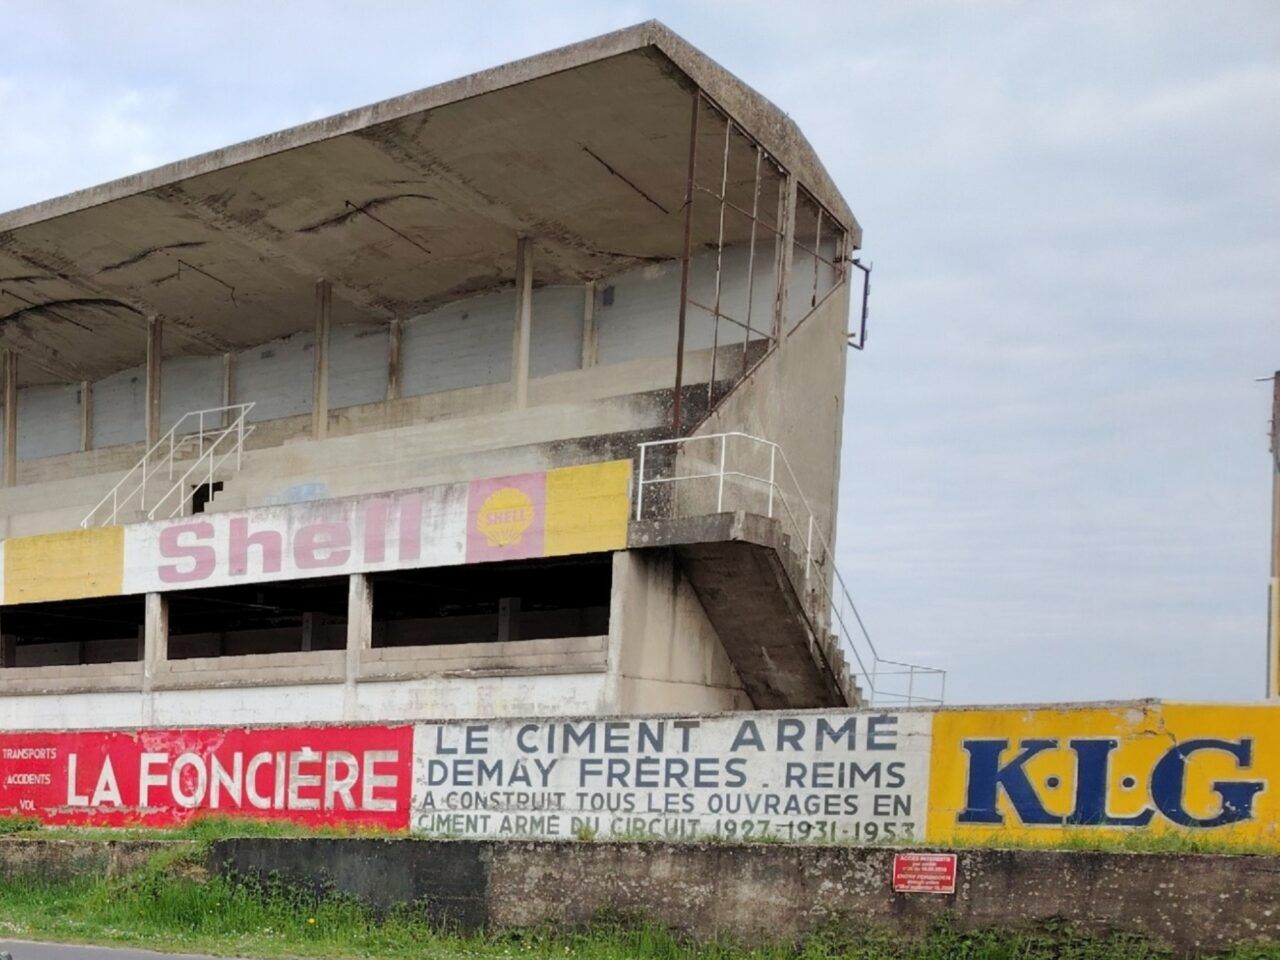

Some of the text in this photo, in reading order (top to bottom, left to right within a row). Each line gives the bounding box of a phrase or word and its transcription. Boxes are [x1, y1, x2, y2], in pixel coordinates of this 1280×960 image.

[486, 507, 527, 526] SHELL
[157, 499, 421, 584] Shell
[436, 724, 489, 755] LE
[516, 721, 700, 754] CIMENT
[2, 748, 57, 760] TRANSPORTS
[7, 773, 51, 785] ACCIDENTS
[67, 747, 399, 812] LA FONCIÈRE
[428, 758, 558, 787] DEMAY
[785, 761, 906, 789] REIMS
[19, 799, 36, 811] VOL
[422, 791, 912, 816] A CONSTRUIT TOUS LES OUVRAGES EN
[417, 813, 491, 834] CIMENT
[570, 816, 600, 836] DU
[610, 816, 701, 838] CIRCUIT
